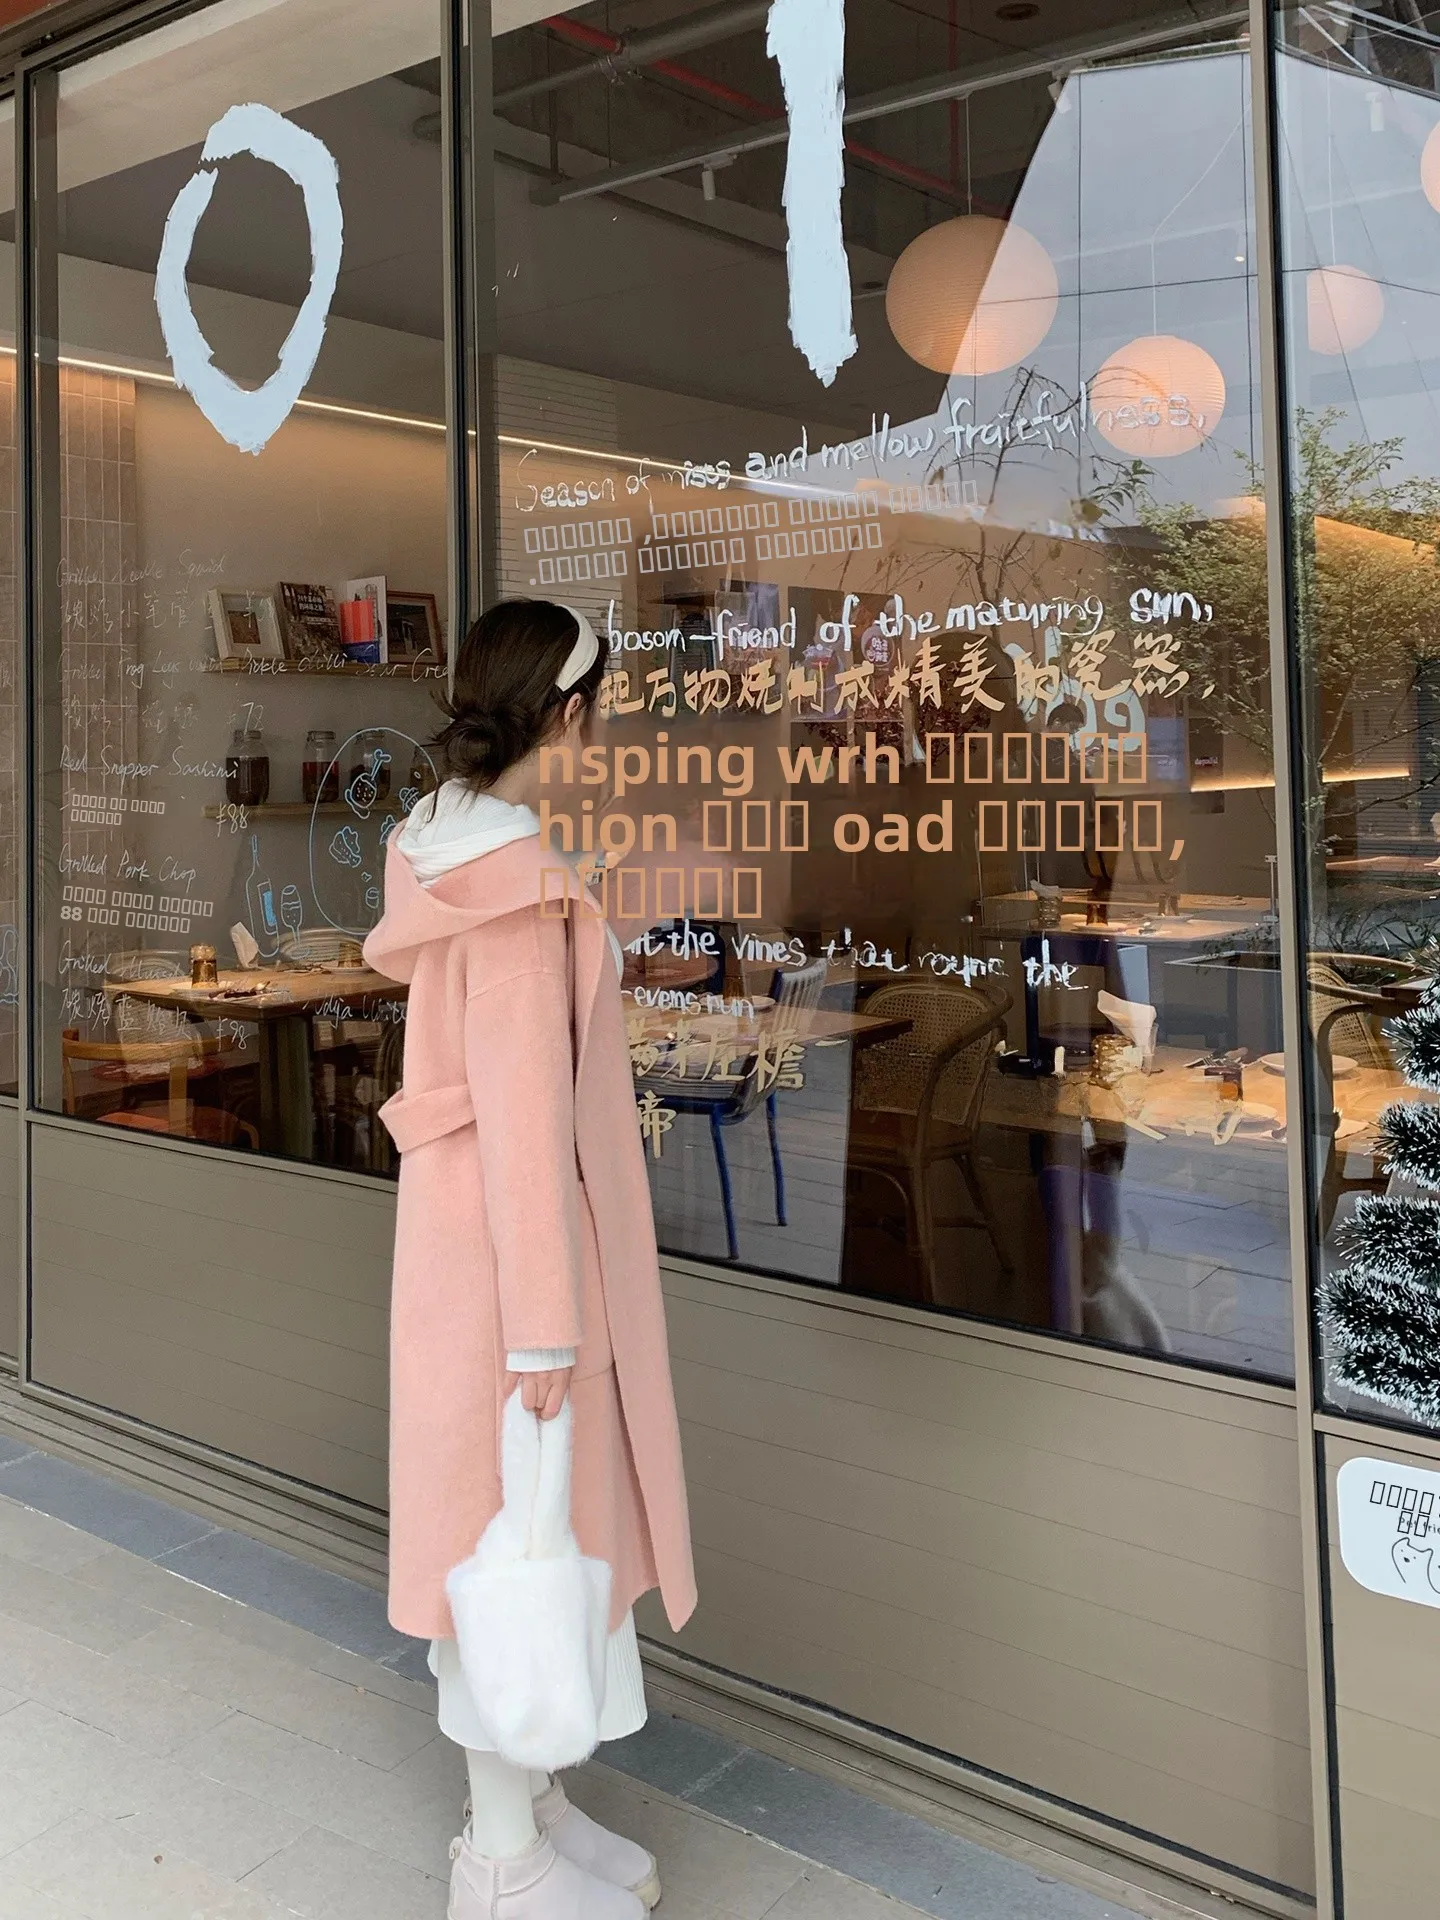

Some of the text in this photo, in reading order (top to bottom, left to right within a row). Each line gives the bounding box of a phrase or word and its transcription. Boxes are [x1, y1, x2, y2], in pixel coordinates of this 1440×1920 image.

[515, 448, 616, 512] Season
[625, 457, 654, 514] of
[745, 425, 809, 480] and
[821, 412, 935, 472] mellow
[819, 594, 861, 651] of
[878, 593, 940, 640] the
[946, 594, 1104, 637] maturing
[1129, 586, 1214, 624] sun,
[168, 745, 240, 779] Sashimi
[58, 842, 197, 894] Grilled Pork Chop
[58, 939, 113, 975] Grilled
[666, 918, 721, 962] the
[731, 932, 808, 968] vines
